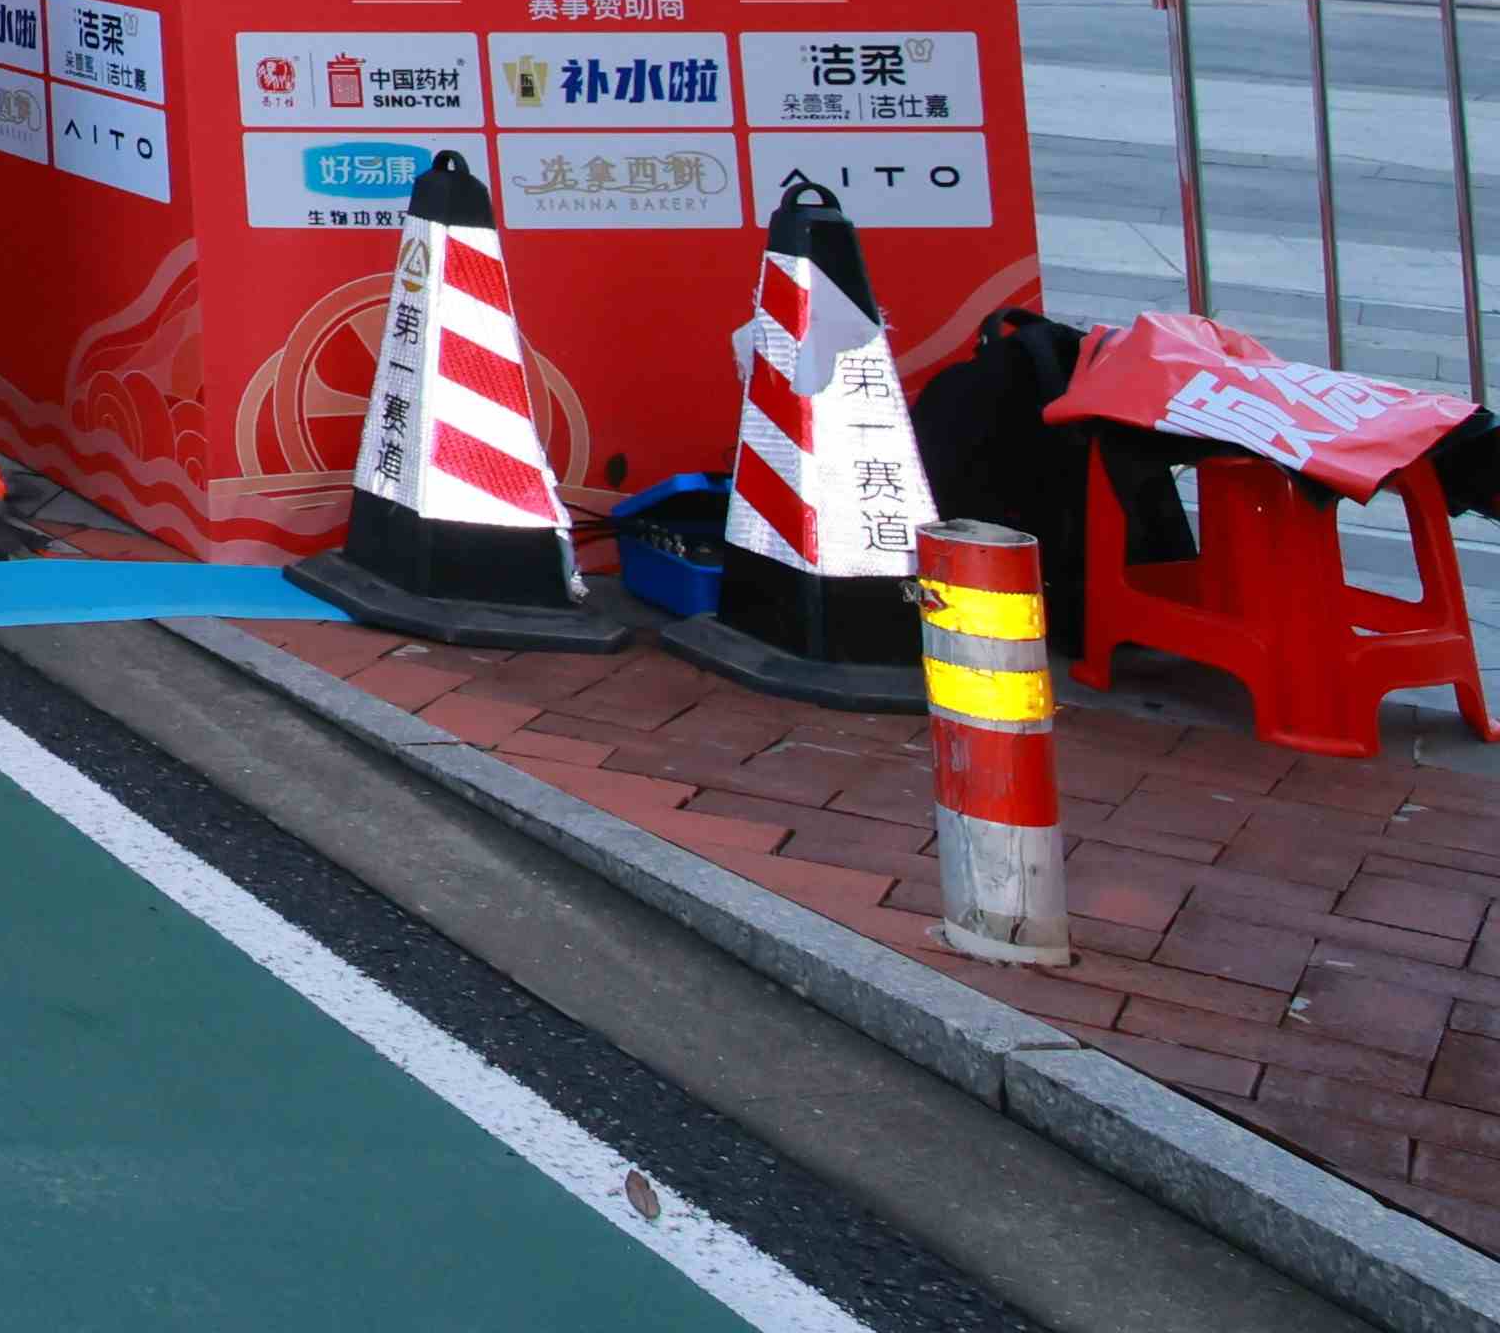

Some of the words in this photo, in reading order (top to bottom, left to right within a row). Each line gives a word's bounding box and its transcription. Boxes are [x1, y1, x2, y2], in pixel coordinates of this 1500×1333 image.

[809, 43, 906, 86] 洁柔
[369, 67, 459, 91] 中国药材
[560, 58, 719, 105] 补水啦
[372, 94, 461, 109] SINO-TCM
[870, 93, 950, 119] 洁仕嘉
[628, 197, 710, 212] BAKERY
[837, 353, 911, 554] 第一赛道
